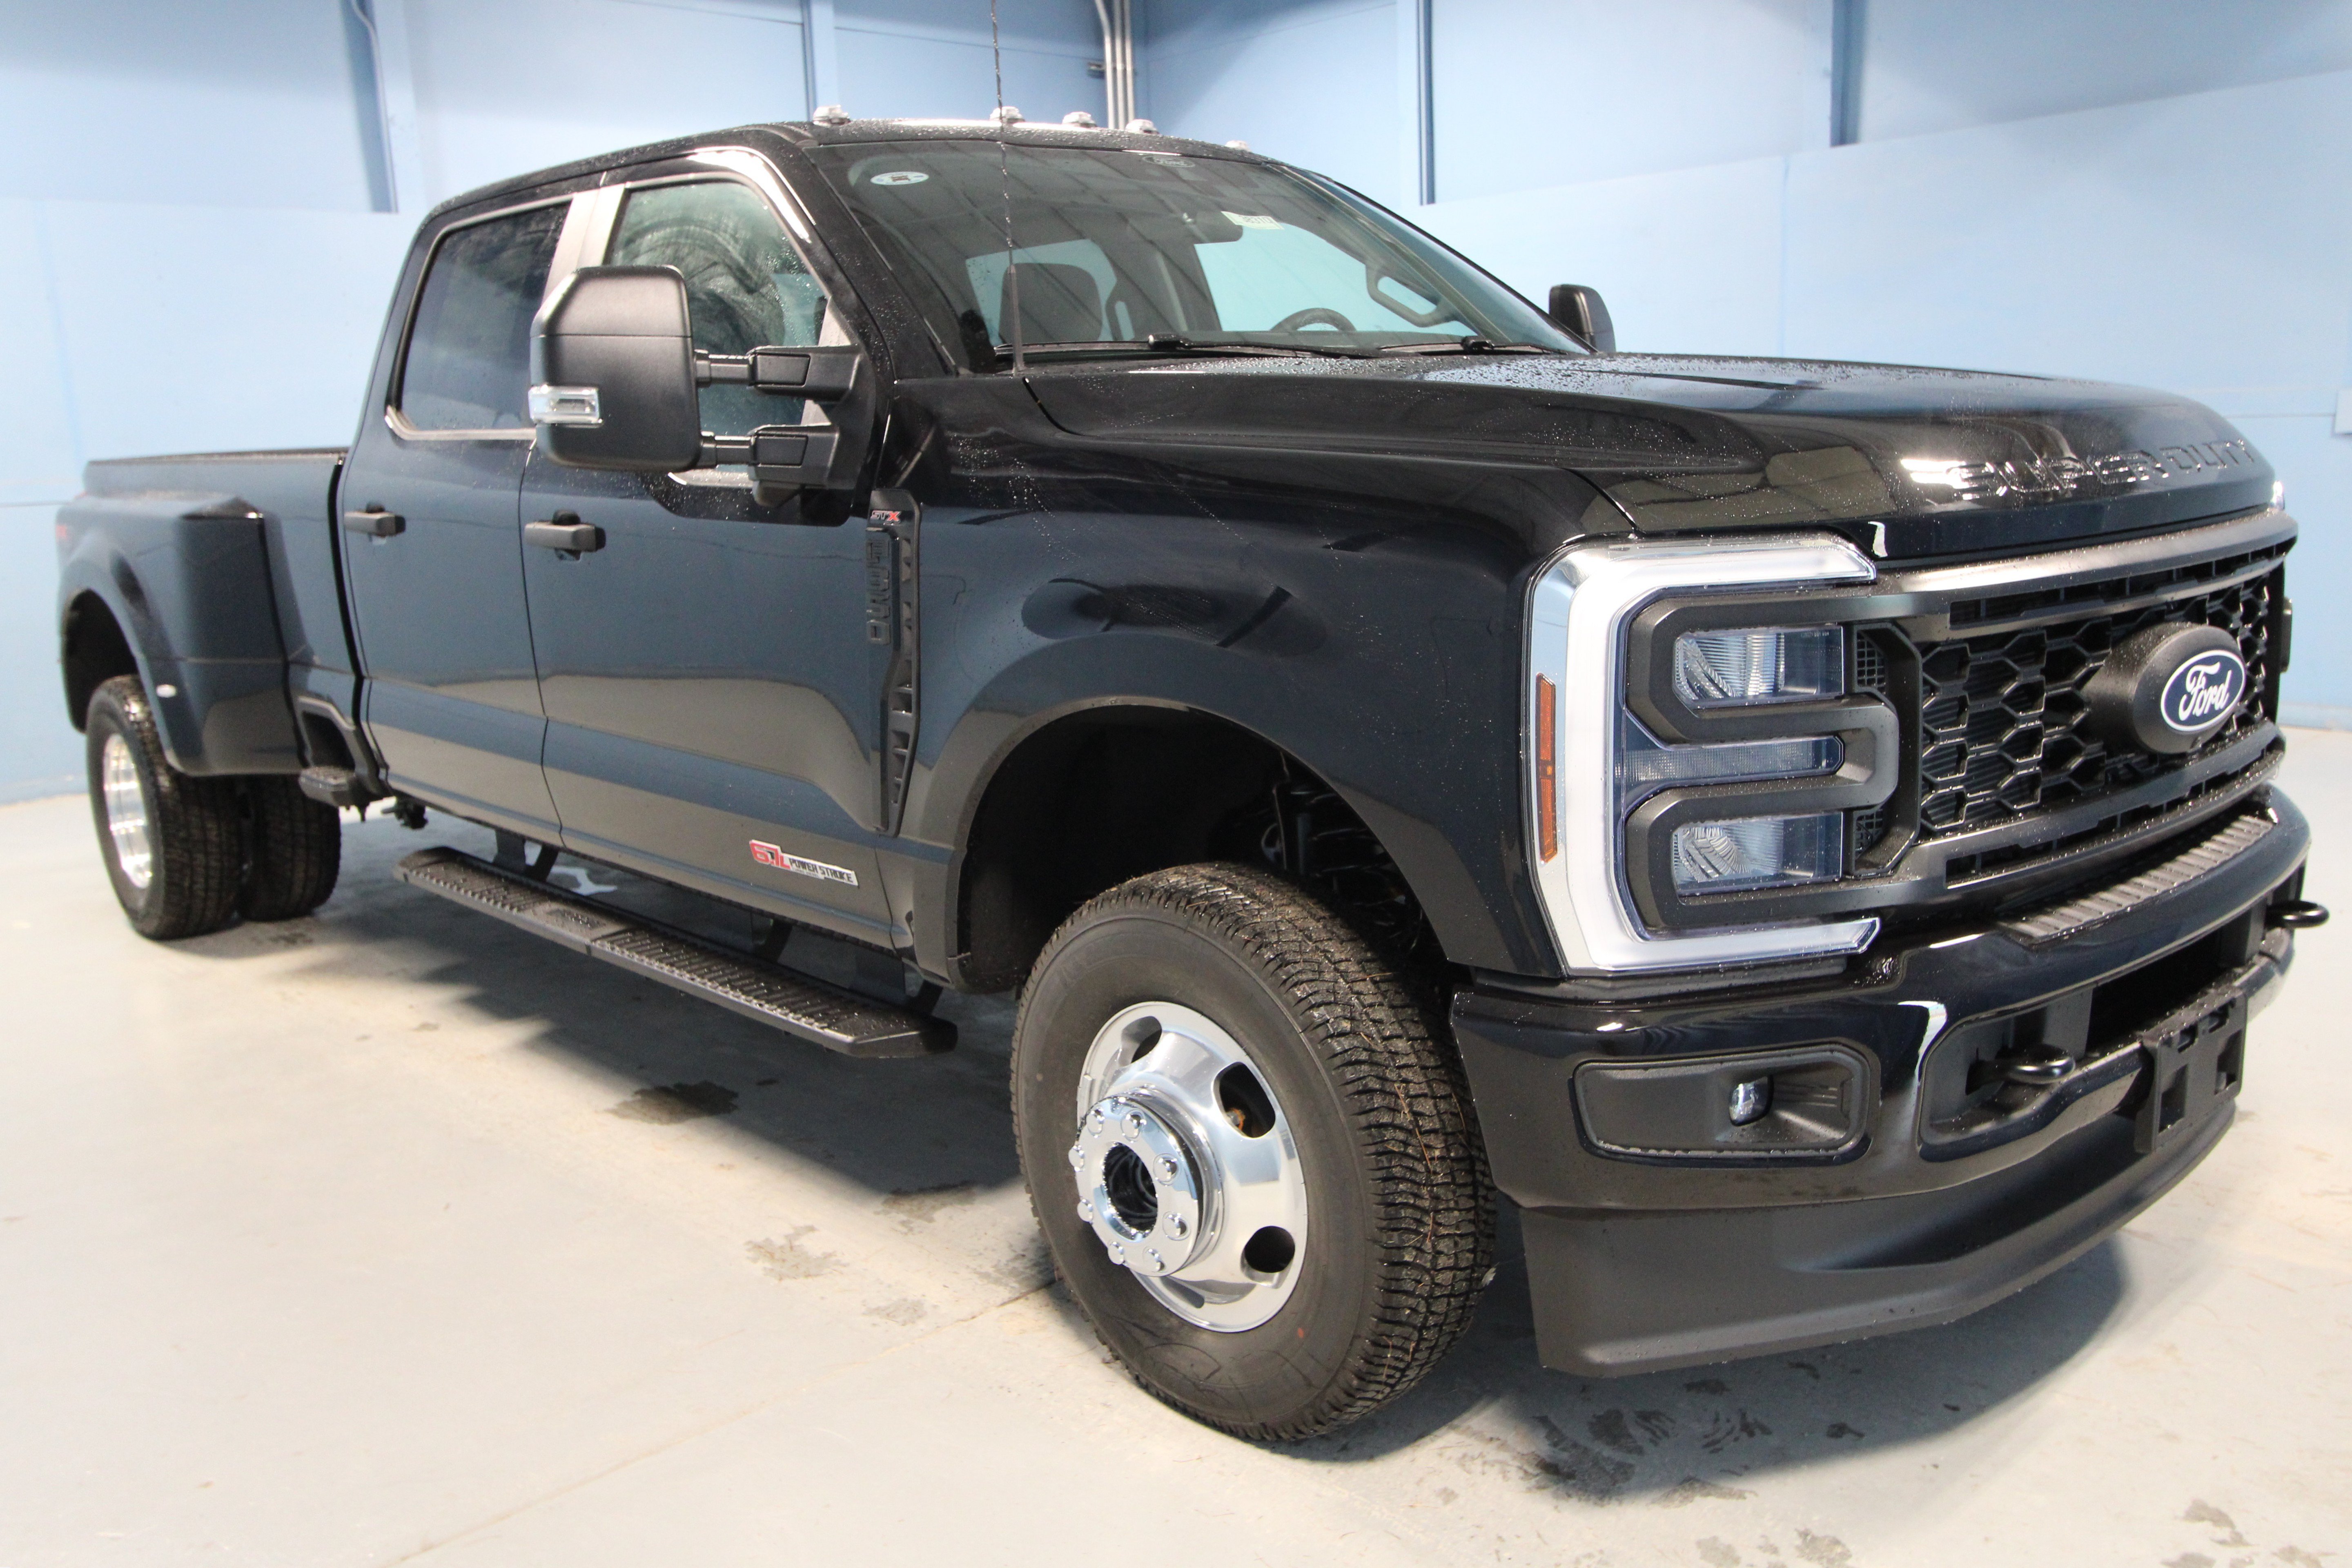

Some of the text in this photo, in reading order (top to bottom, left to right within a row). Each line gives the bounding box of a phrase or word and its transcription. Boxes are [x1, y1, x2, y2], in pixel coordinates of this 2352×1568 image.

[2160, 439, 2255, 472] DUTY
[870, 510, 901, 522] STX
[2178, 662, 2233, 722] Ford
[788, 858, 818, 873] POWER
[818, 865, 854, 883] STROKE
